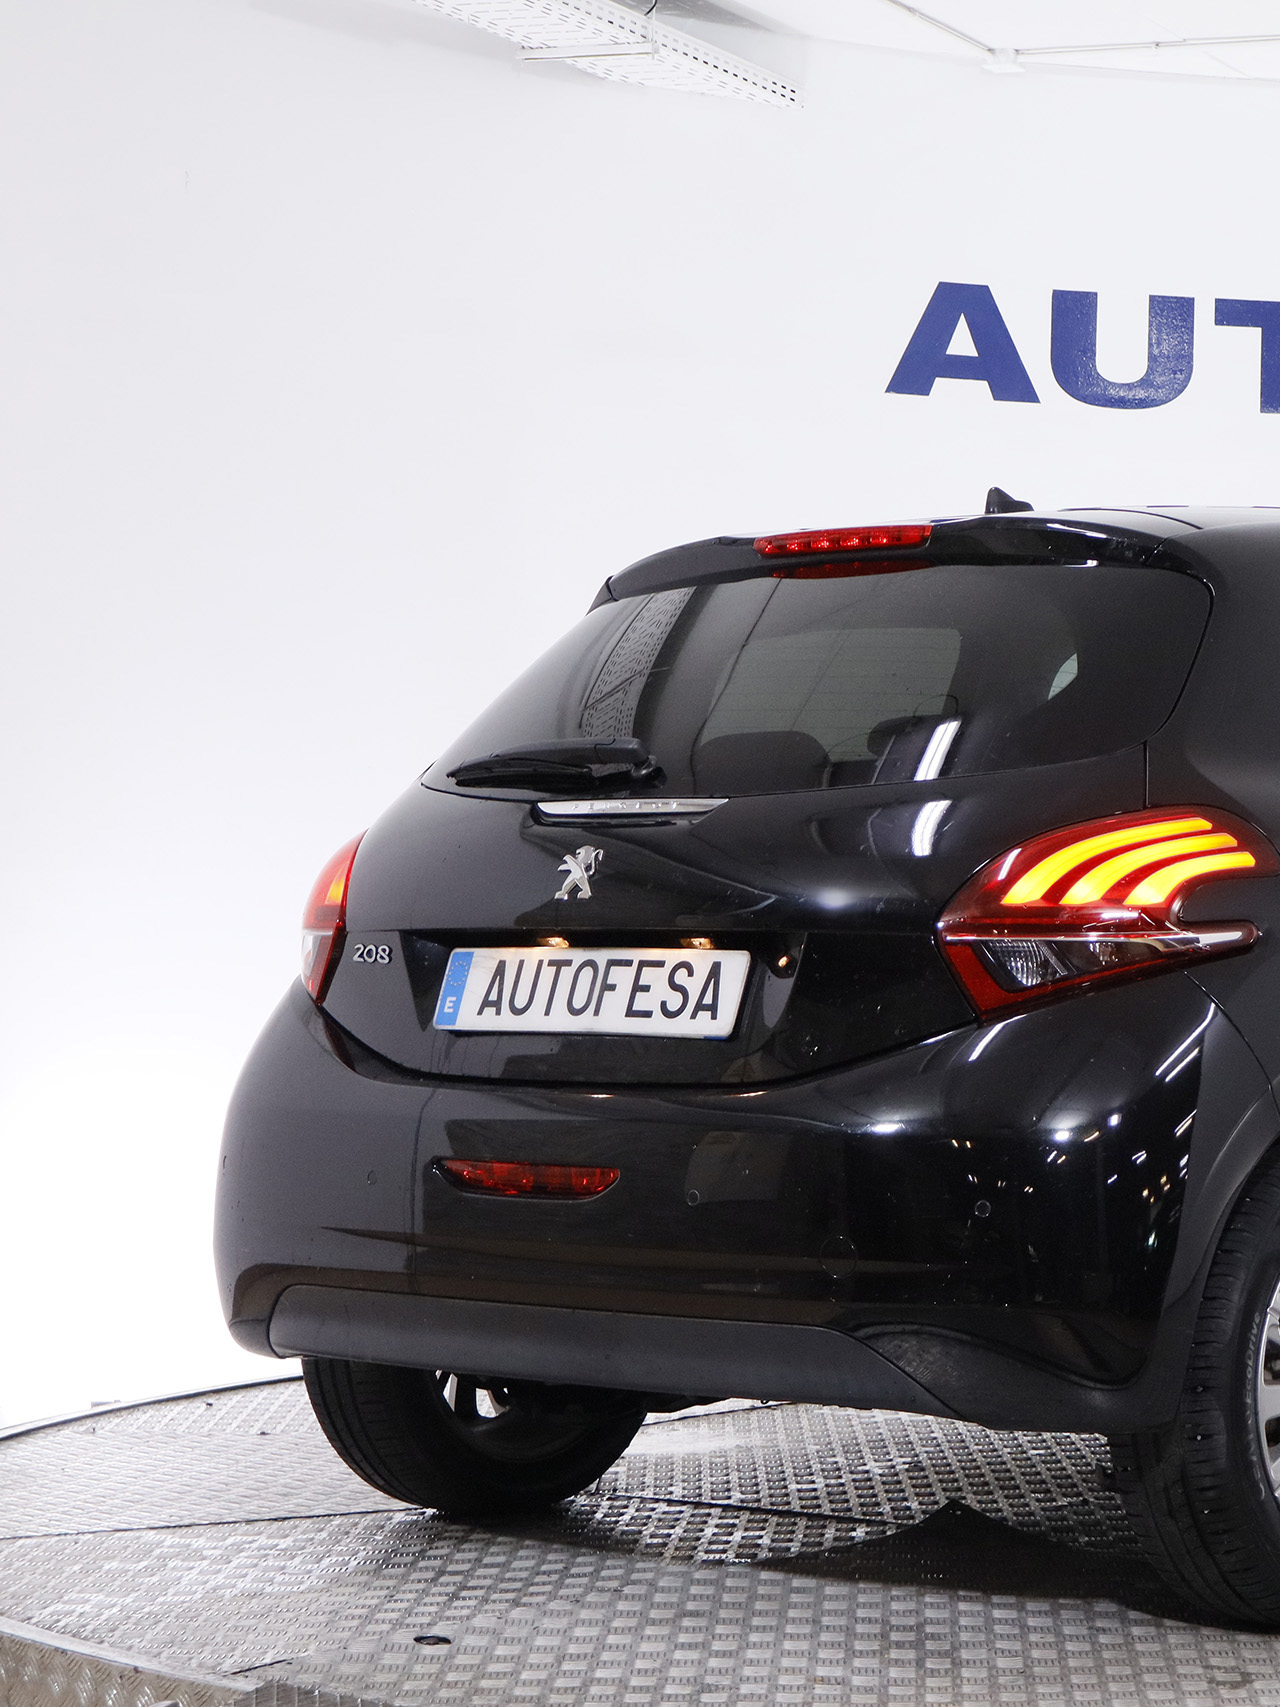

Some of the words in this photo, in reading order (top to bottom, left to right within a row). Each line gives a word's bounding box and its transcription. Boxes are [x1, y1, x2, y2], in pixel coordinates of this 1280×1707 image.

[352, 943, 390, 964] 208
[443, 996, 456, 1013] E
[476, 957, 723, 1021] AUTOFESA
[1245, 1311, 1261, 1403] EcoDrive
